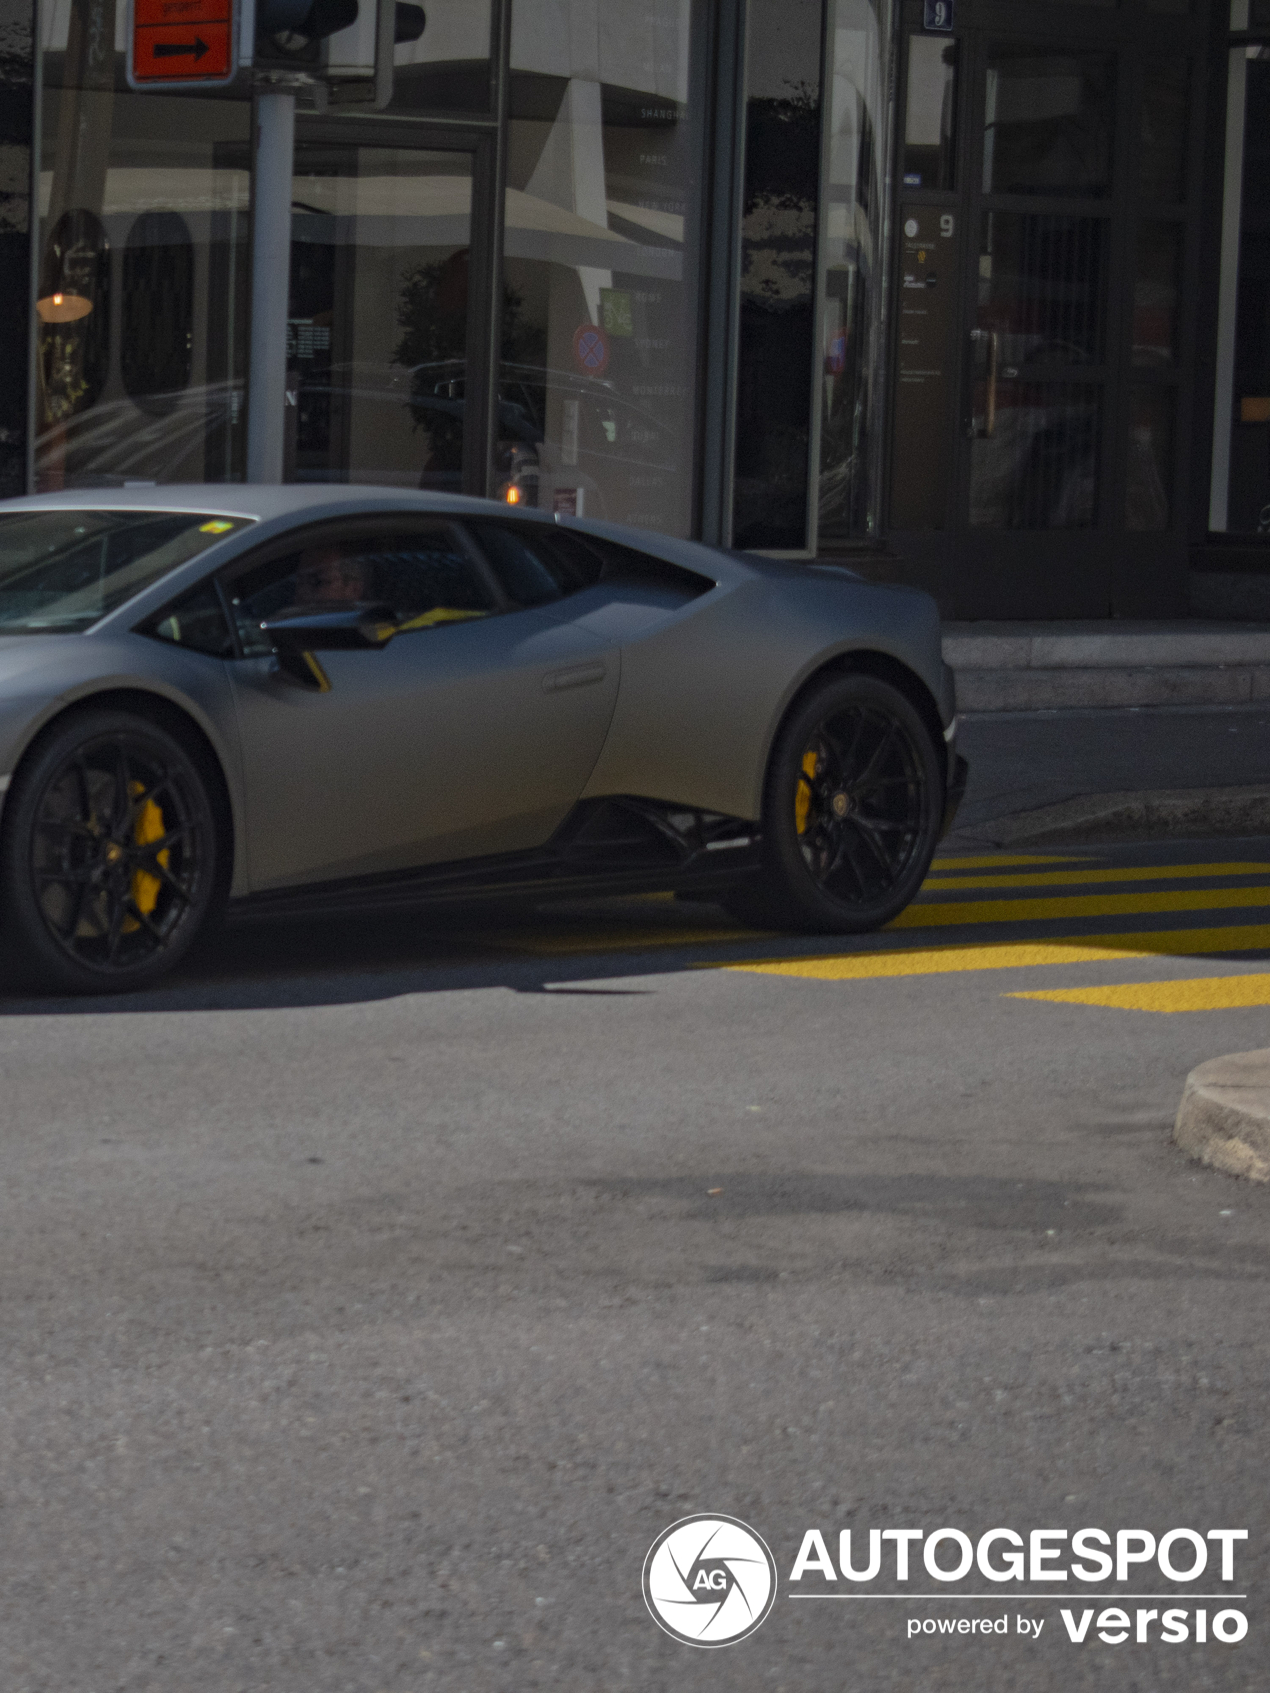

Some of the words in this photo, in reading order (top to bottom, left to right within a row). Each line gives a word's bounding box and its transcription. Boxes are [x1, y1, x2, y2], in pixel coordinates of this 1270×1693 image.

[935, 2, 946, 26] 9
[639, 153, 668, 166] PARIS
[940, 214, 954, 238] 9
